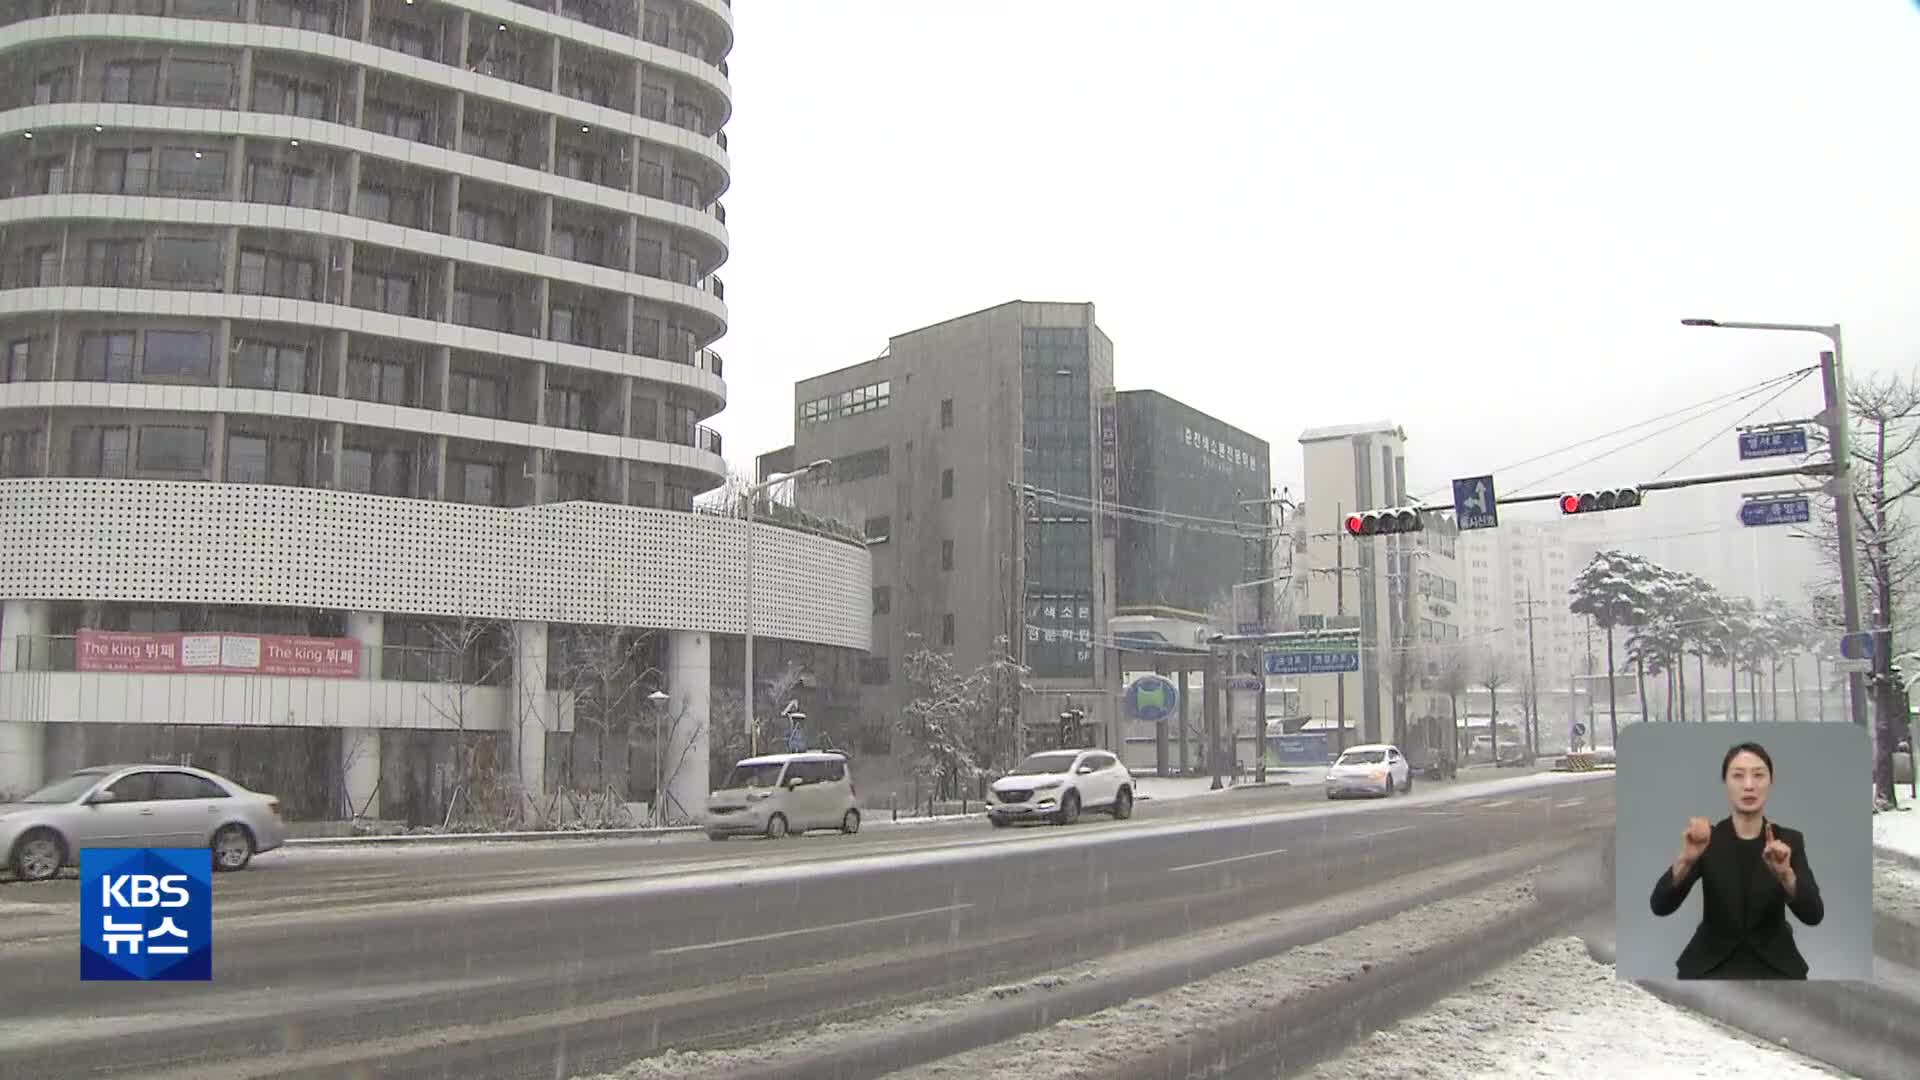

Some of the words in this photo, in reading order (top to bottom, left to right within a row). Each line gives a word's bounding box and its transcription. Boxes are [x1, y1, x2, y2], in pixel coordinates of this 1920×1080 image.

[82, 642, 109, 656] The
[111, 642, 142, 659] king
[146, 642, 175, 660] 뷔페
[267, 645, 292, 658] The
[295, 647, 322, 663] king
[326, 648, 354, 664] 뷔페
